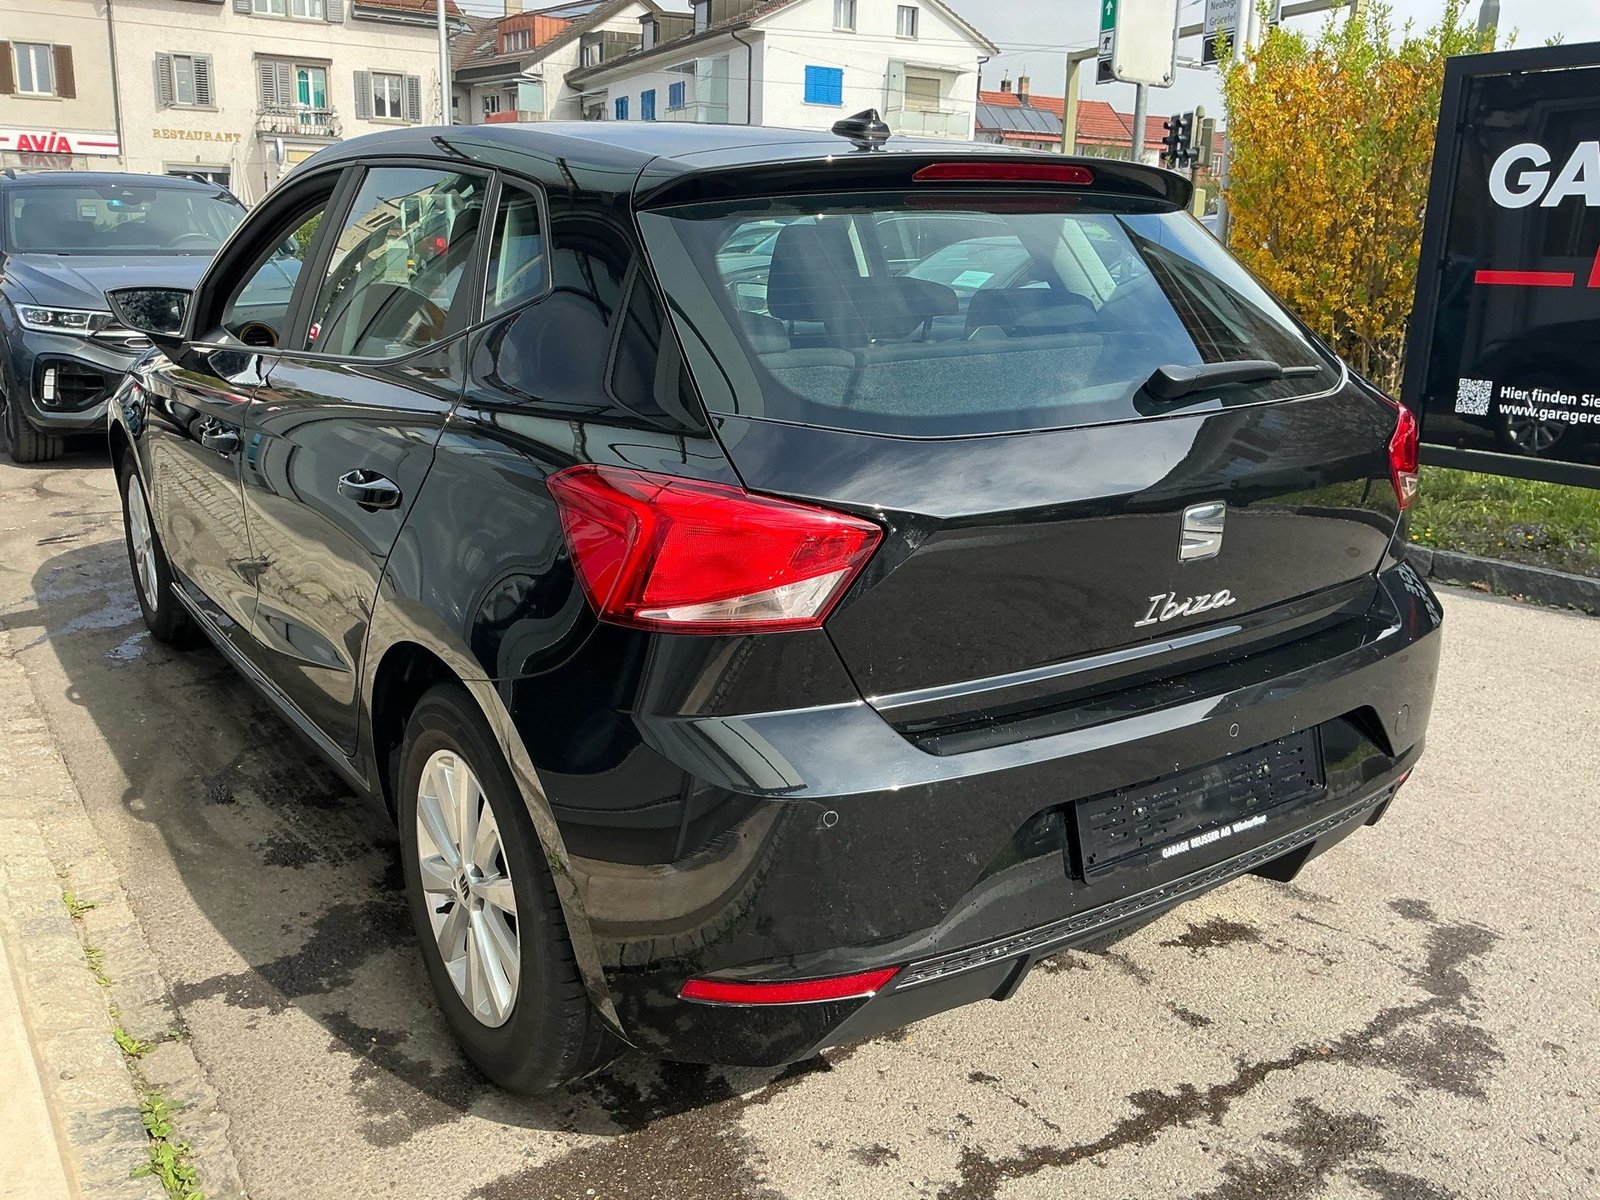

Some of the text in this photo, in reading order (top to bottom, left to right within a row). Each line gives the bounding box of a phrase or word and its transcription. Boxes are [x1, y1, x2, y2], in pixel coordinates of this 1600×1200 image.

[152, 128, 242, 142] RESTAURANT
[1500, 386, 1600, 408] Hier finden Sie
[1499, 403, 1600, 425] www.garagere
[1133, 589, 1237, 628] Ibiza
[1162, 841, 1190, 859] GARAGE
[1220, 825, 1232, 838] AG
